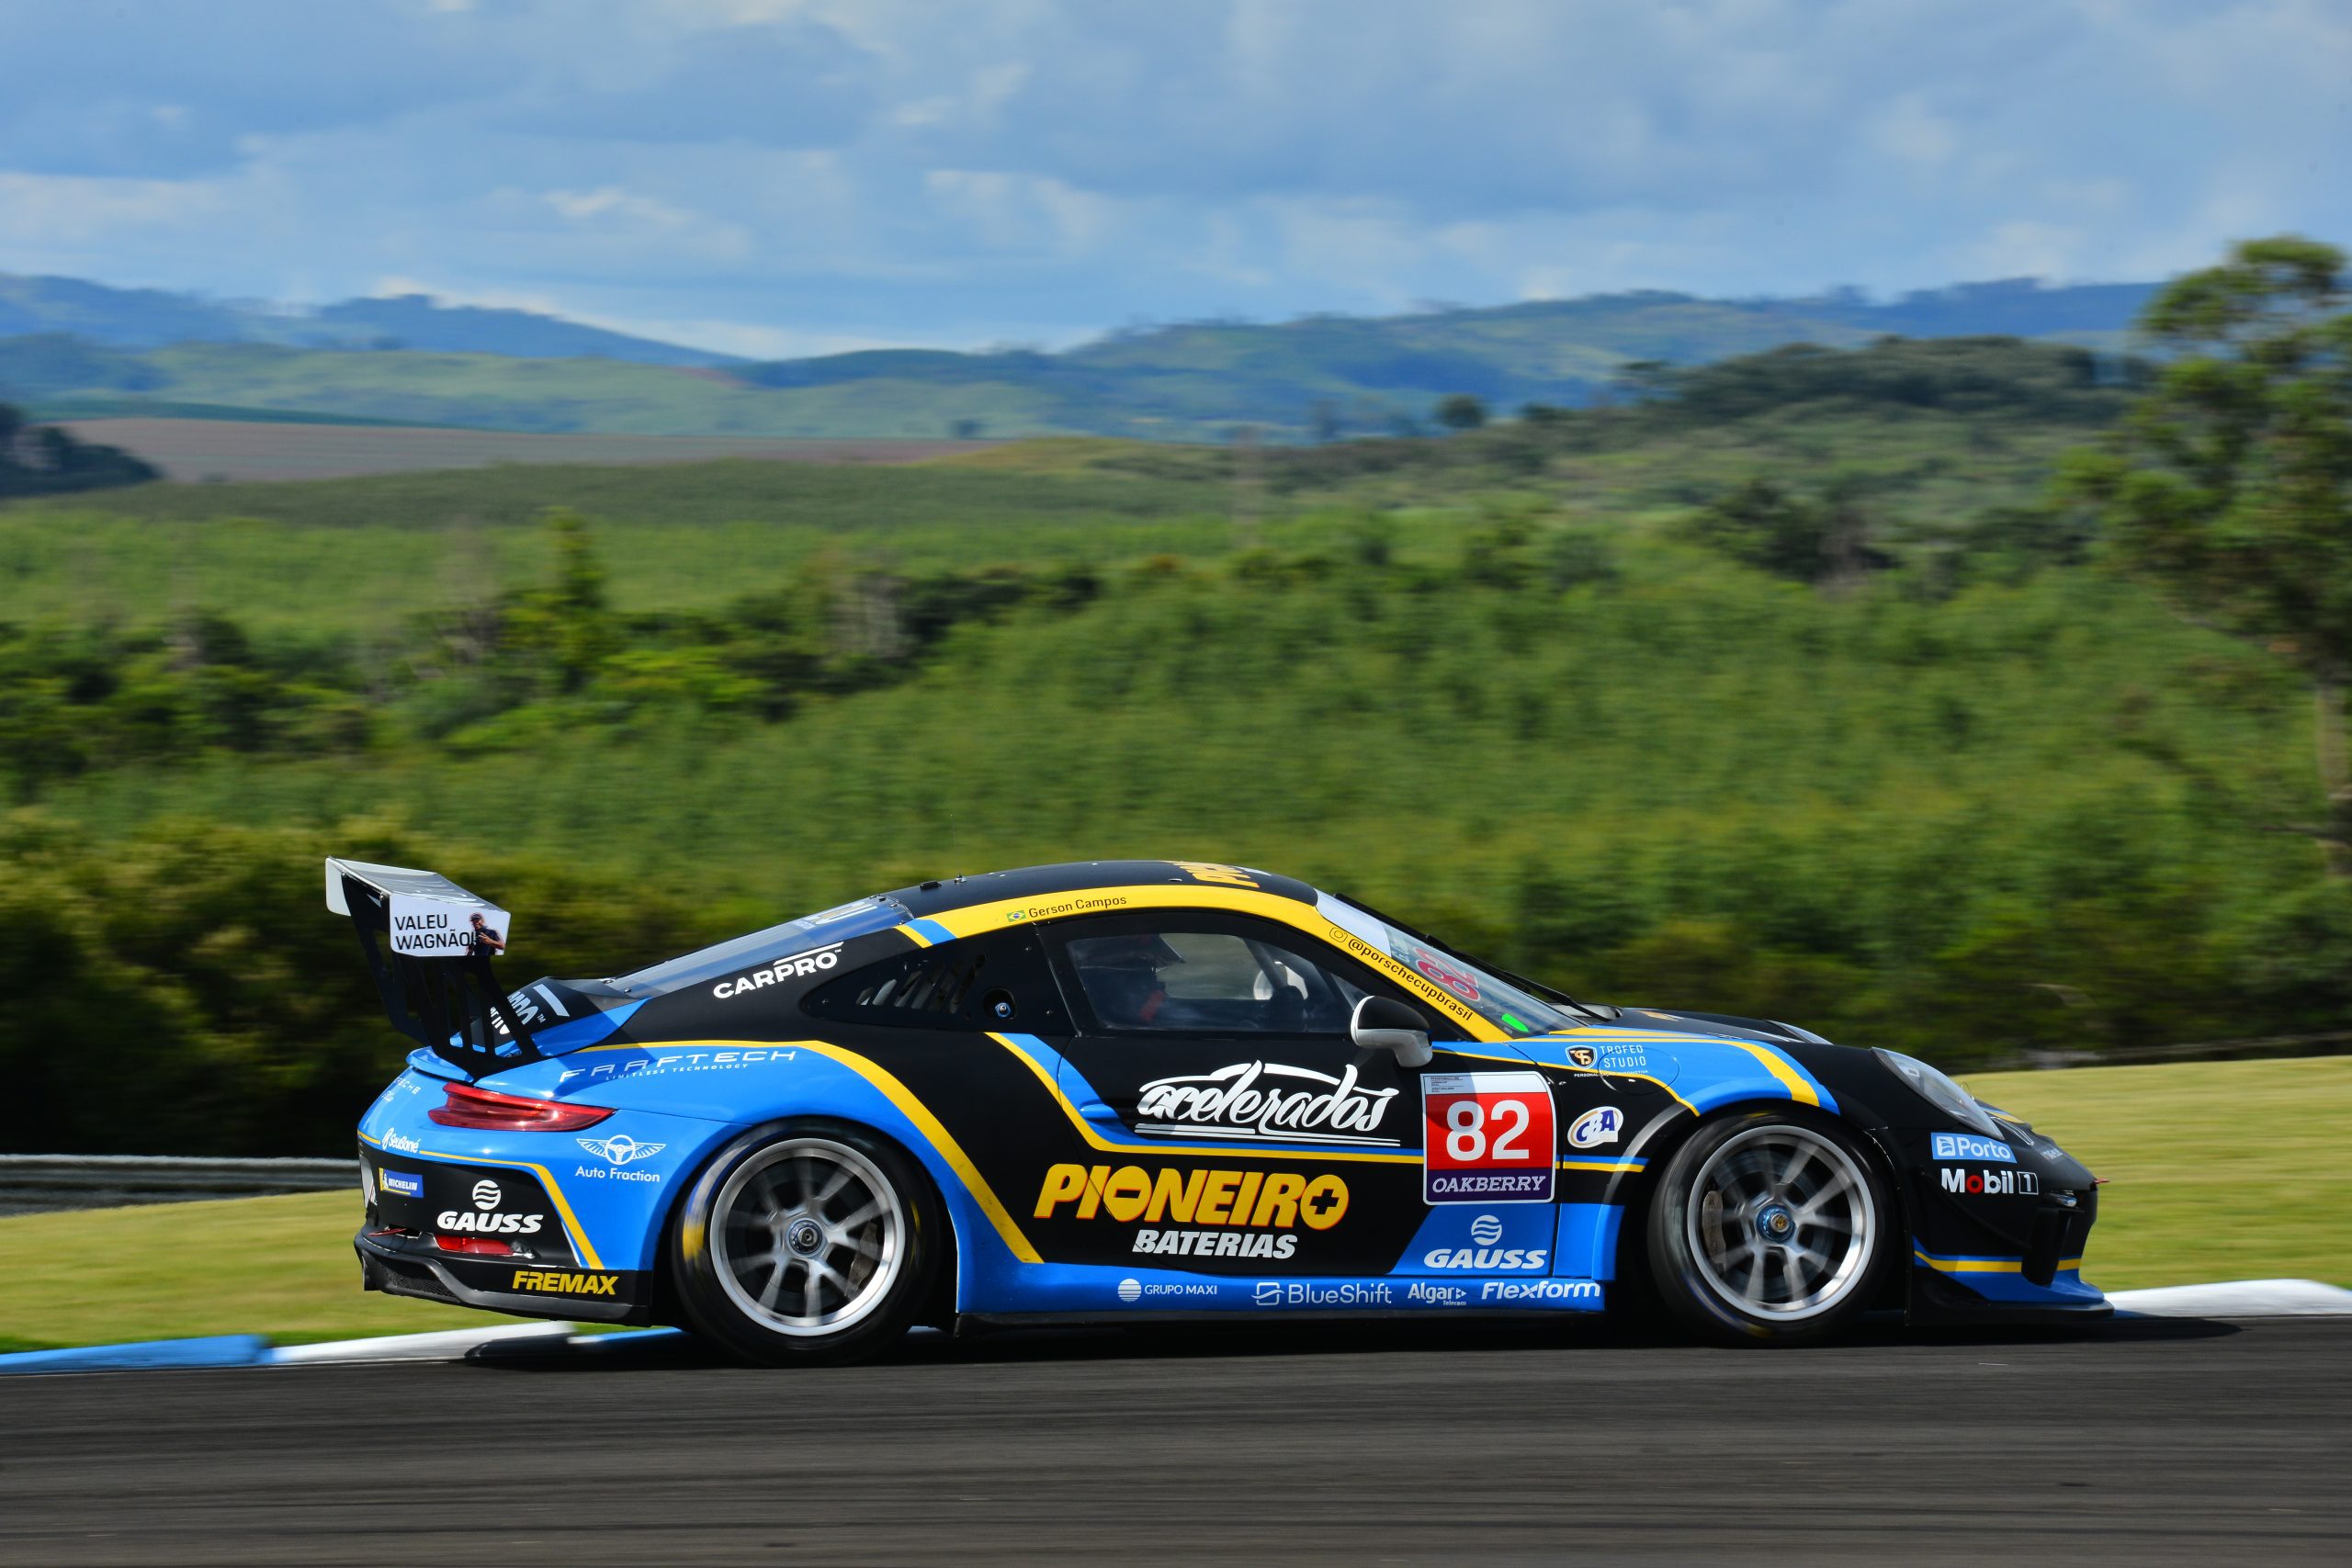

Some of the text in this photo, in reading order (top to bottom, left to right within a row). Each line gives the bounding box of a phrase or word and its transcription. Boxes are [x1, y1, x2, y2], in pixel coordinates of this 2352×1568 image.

[1028, 896, 1127, 919] Gerson Campos
[395, 914, 447, 931] VALEU
[713, 952, 838, 998] CARPRO
[1348, 938, 1474, 1021] @porschecupbrasil
[1600, 1044, 1644, 1055] TROFEO
[605, 1063, 749, 1081] LIMITLESS TECHNOLOGY
[1603, 1055, 1646, 1068] STUDIO
[1136, 1060, 1399, 1134] acelerados
[1446, 1100, 1530, 1161] 82
[1956, 1136, 2011, 1159] Porto
[388, 1178, 418, 1191] MICHELIN
[575, 1166, 661, 1183] Auto Fraction
[1431, 1176, 1546, 1193] OAKBERRY
[1941, 1168, 2014, 1194] Mobil
[1033, 1163, 1350, 1231] PIONEIRO
[436, 1211, 544, 1234] GAUSS
[1132, 1229, 1298, 1259] BATERIAS
[1424, 1248, 1547, 1269] GAUSS
[512, 1270, 619, 1295] FREMAX
[1144, 1285, 1218, 1296] GRUPO MAXI
[1288, 1282, 1394, 1305] BlueShift
[1407, 1281, 1454, 1304] Algar
[1481, 1280, 1601, 1301] Flexform
